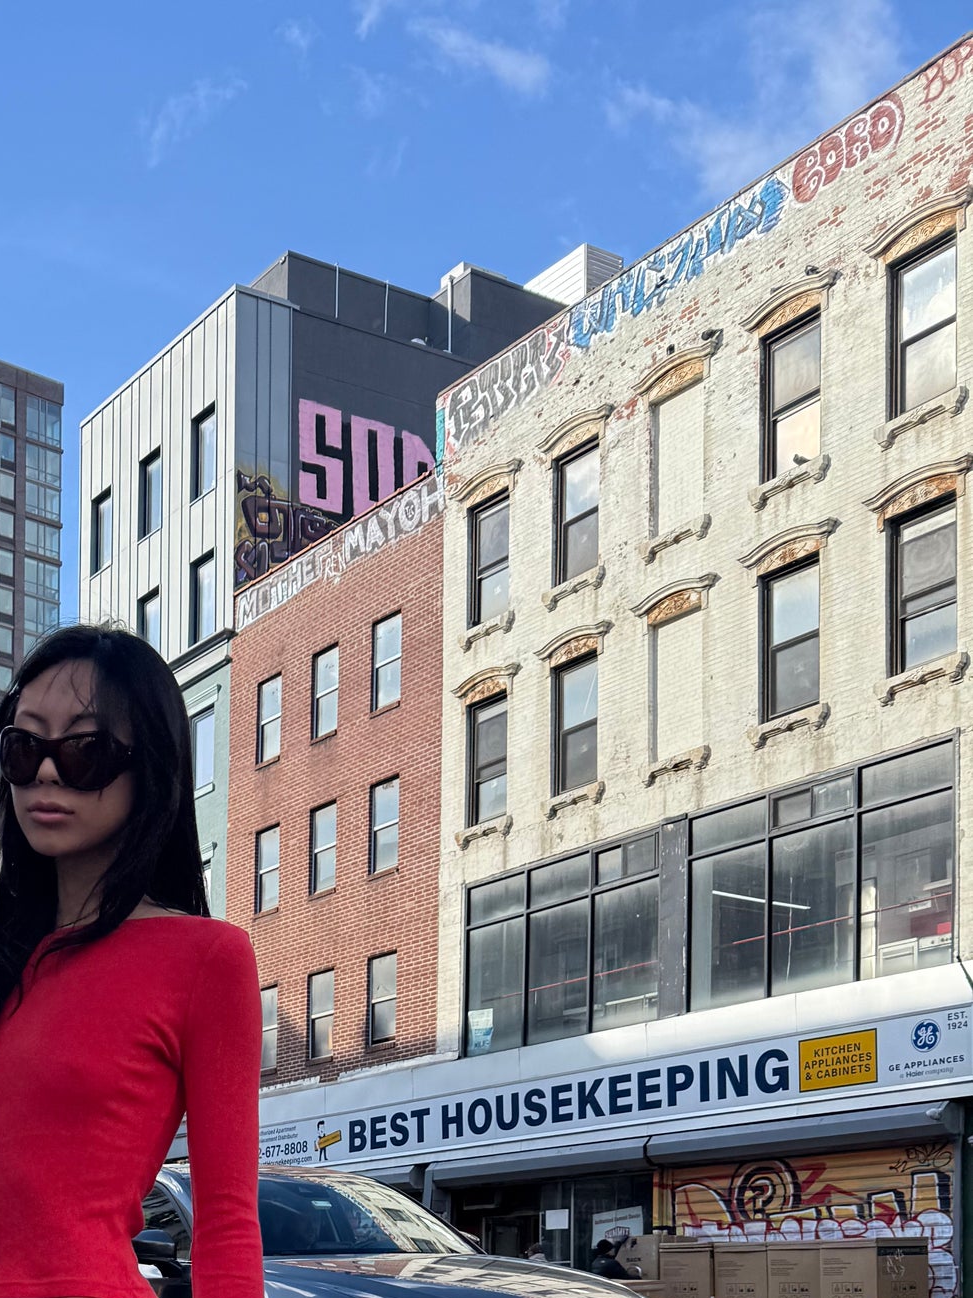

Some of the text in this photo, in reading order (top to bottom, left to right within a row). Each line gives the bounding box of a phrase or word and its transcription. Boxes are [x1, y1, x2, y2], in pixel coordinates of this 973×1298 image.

[947, 1010, 969, 1021] EST.
[947, 1020, 969, 1031] 1924
[813, 1042, 862, 1058] KITCHEN
[803, 1052, 873, 1071] APPLIANCES
[888, 1054, 966, 1072] GE APPLIANCES
[805, 1064, 872, 1081] & CABINETS
[905, 1070, 924, 1078] Haier
[924, 1066, 954, 1077] company
[348, 1048, 790, 1153] BEST HOUSEKEEPING
